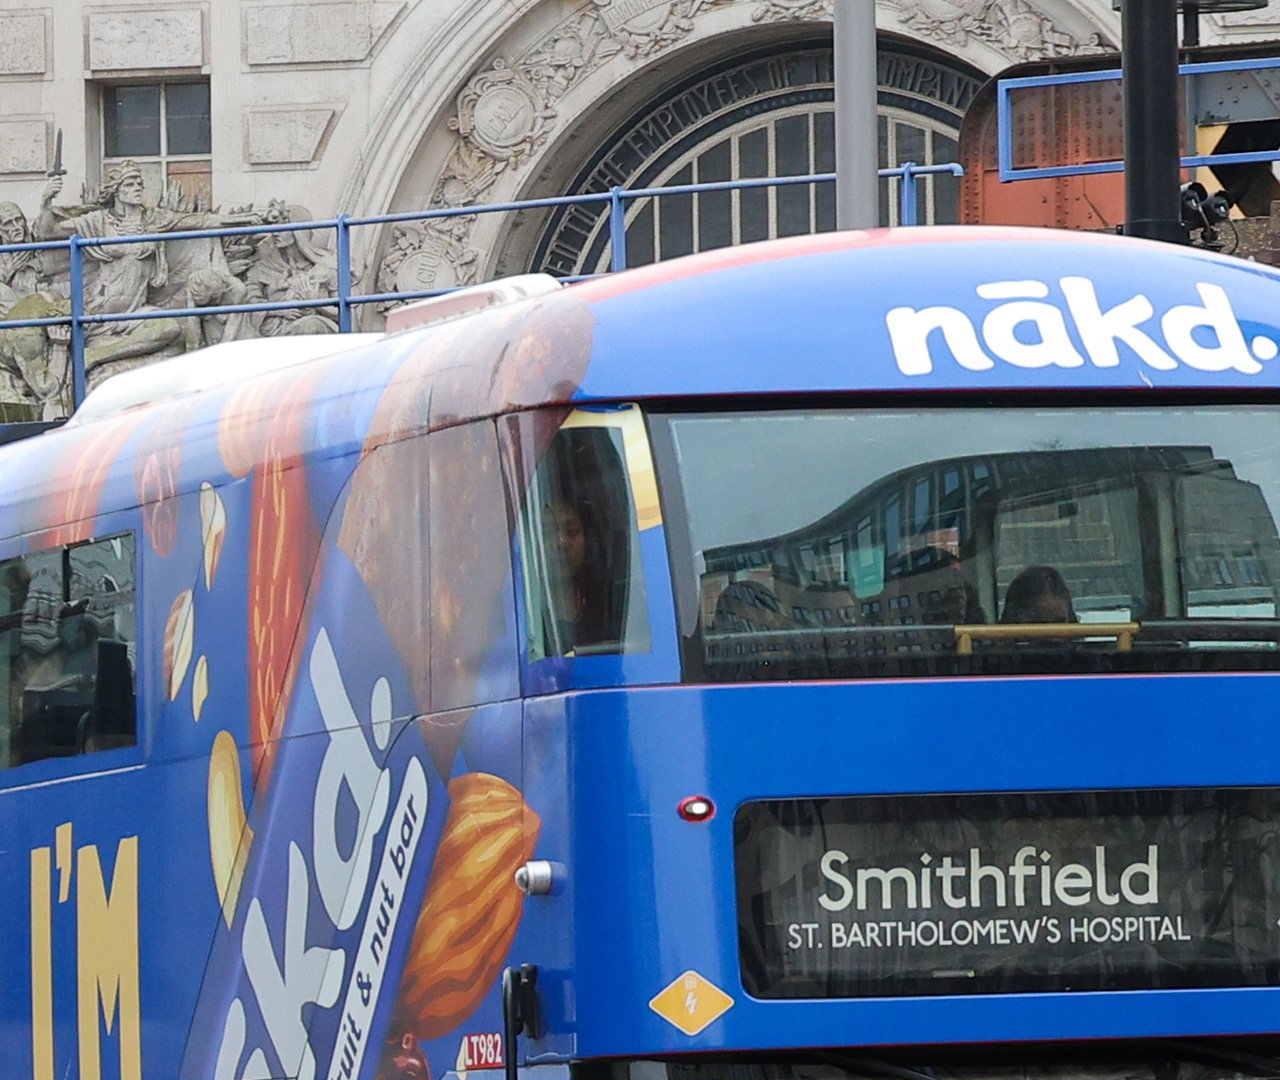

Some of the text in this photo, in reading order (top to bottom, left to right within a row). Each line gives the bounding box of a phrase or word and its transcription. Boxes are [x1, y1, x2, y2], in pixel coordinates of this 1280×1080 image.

[627, 68, 760, 160] EMPLOYEES
[355, 970, 372, 1005] &
[371, 881, 396, 964] nut
[391, 794, 420, 877] bar
[818, 844, 1160, 912] Smithfield
[787, 916, 1191, 951] ST. BARTHOLOMEW'S HOSPITAL
[464, 1033, 503, 1066] LT982
